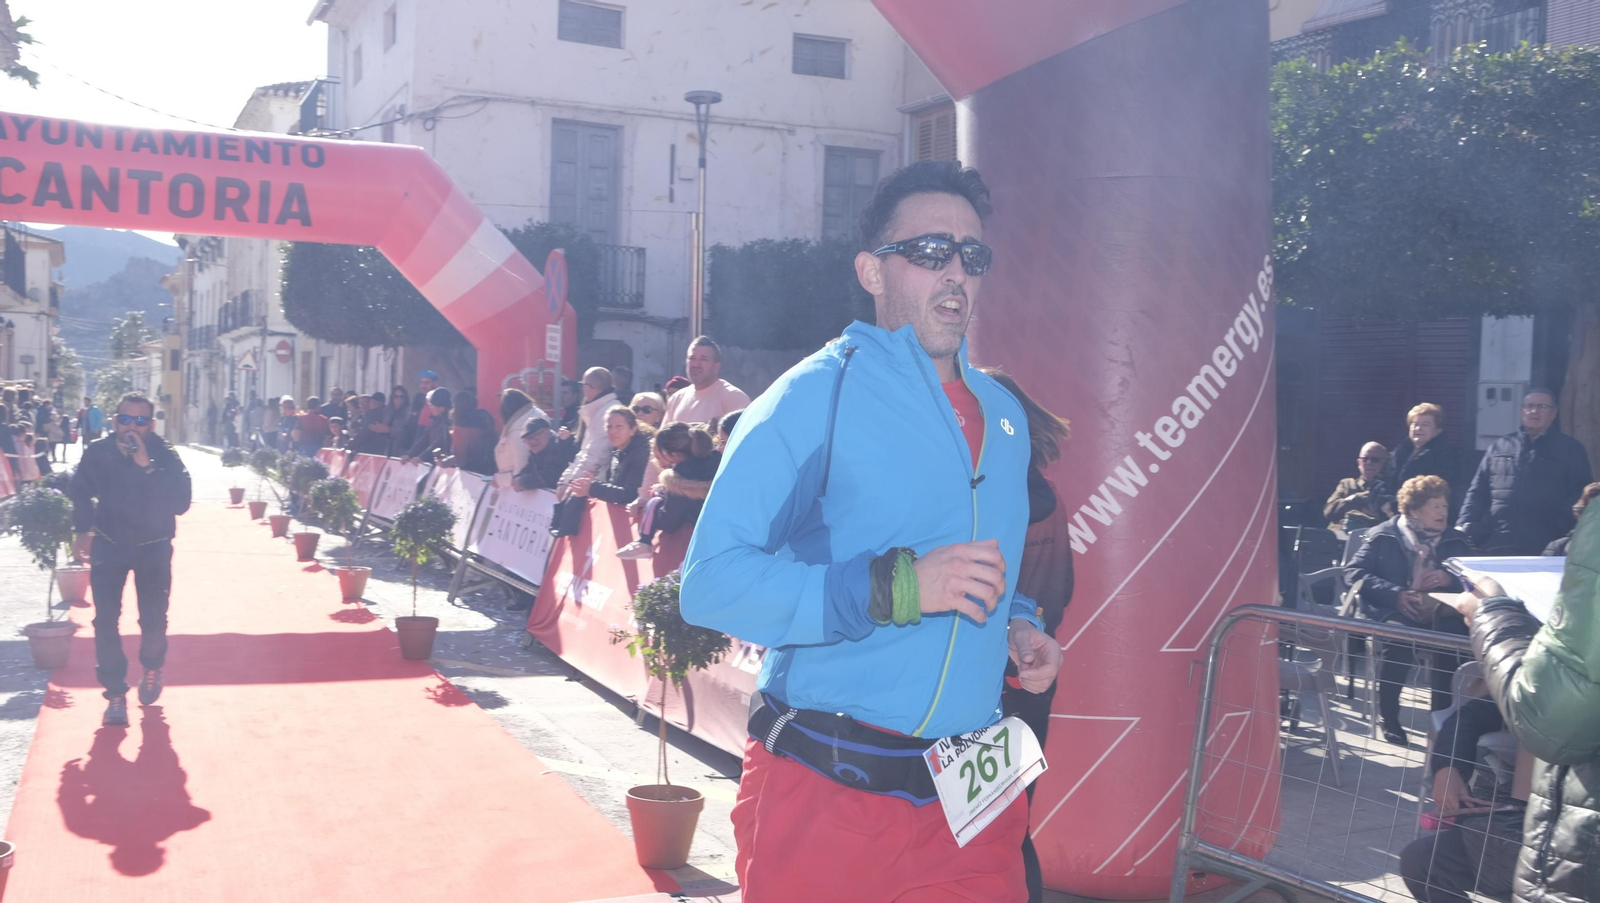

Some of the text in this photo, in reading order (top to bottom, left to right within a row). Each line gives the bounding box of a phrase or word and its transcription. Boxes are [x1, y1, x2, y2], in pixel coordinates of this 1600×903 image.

[0, 156, 313, 228] CANTORIA
[1067, 254, 1274, 555] www.teamergy.es
[941, 754, 955, 769] LA
[959, 726, 1012, 804] 267
